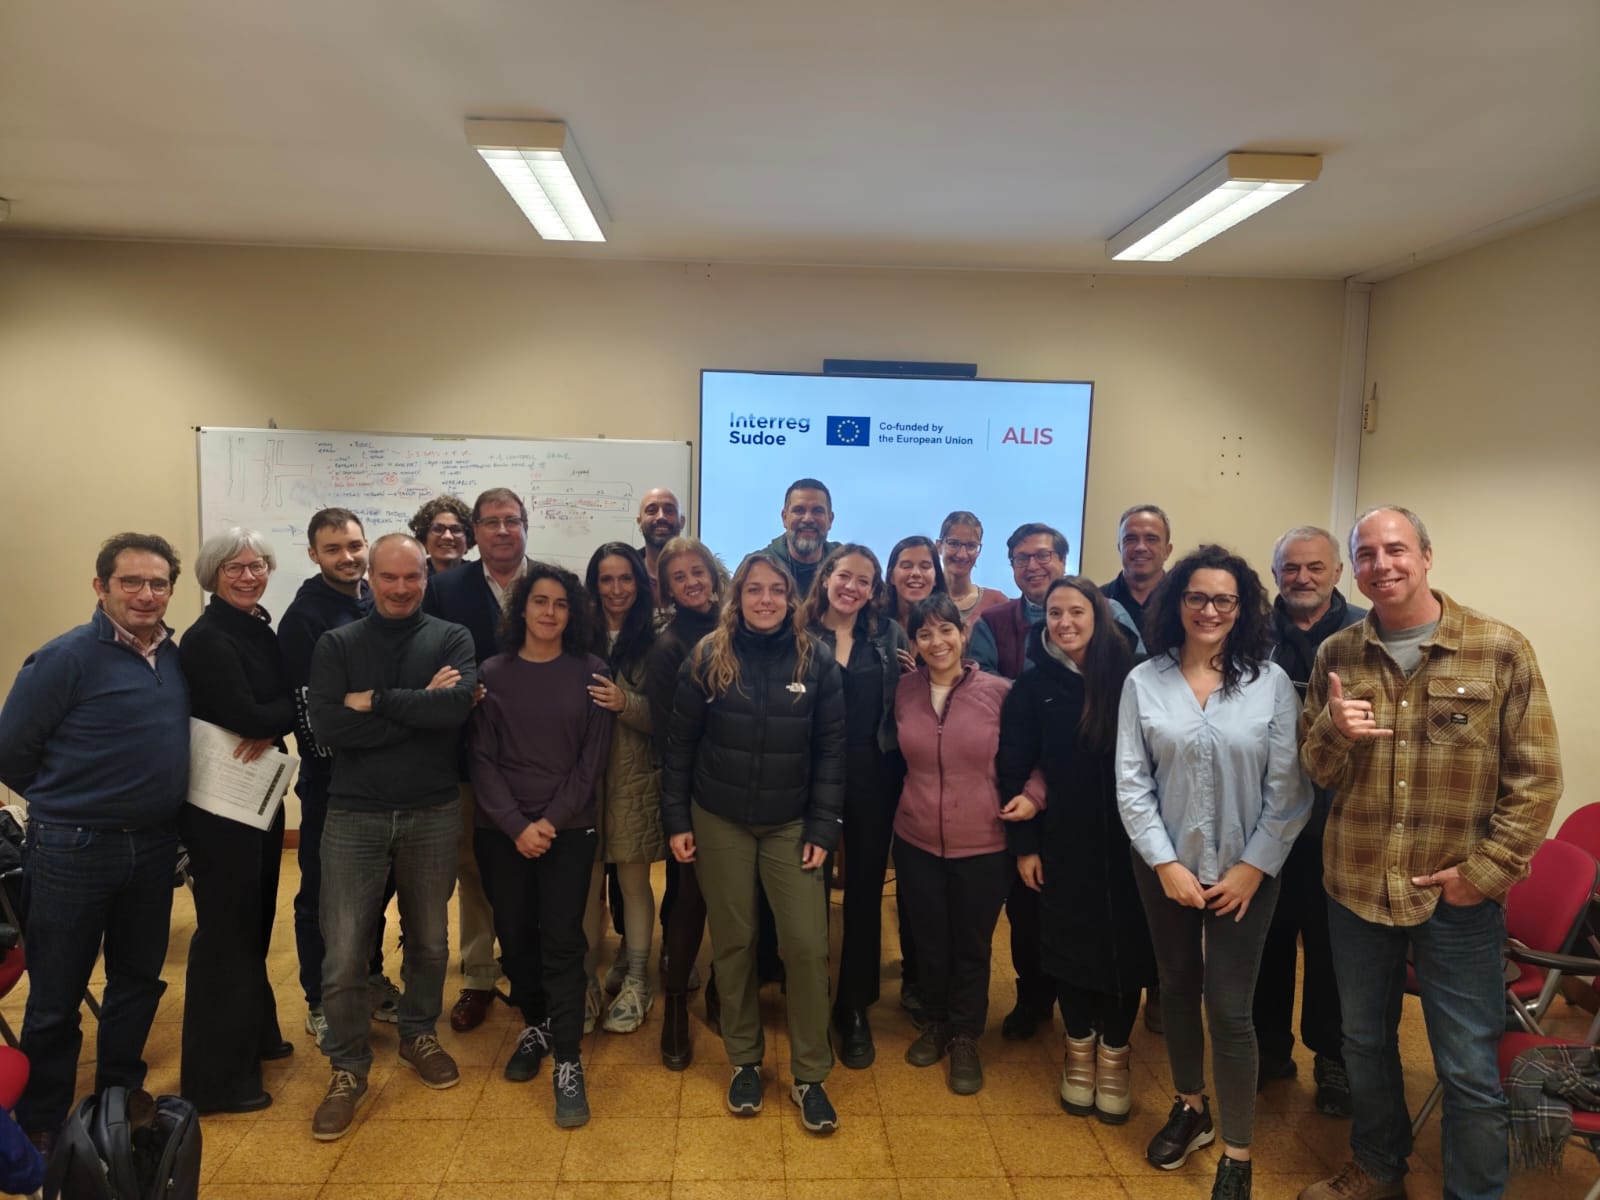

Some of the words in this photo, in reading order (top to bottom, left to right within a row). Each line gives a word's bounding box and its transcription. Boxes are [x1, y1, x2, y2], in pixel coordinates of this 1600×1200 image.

[730, 412, 811, 433] Interreg
[879, 422, 929, 432] Co-funded
[931, 423, 944, 433] by
[729, 430, 787, 446] Sudoe
[879, 434, 894, 443] the
[896, 434, 942, 446] European
[945, 436, 973, 445] Union
[1001, 427, 1053, 445] ALIS
